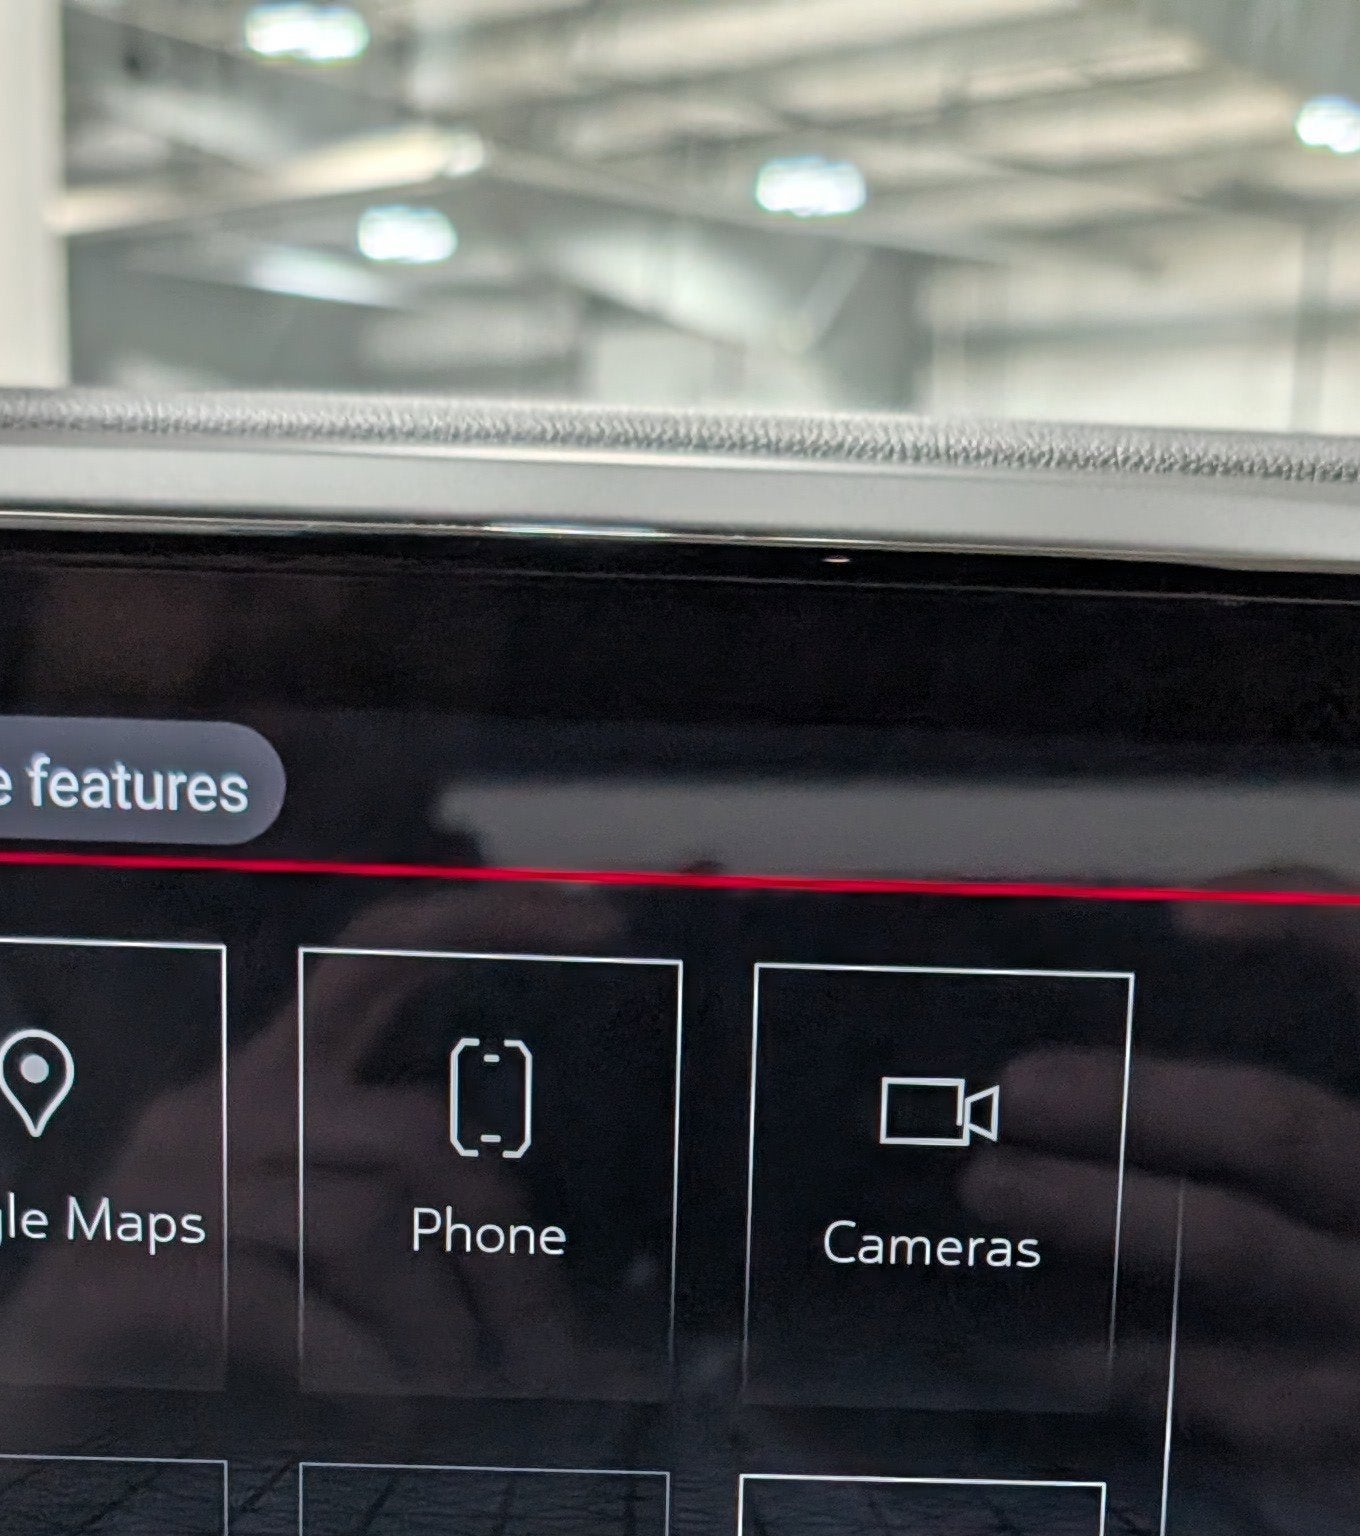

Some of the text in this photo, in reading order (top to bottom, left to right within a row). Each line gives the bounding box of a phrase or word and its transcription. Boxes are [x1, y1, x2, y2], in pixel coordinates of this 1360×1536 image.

[27, 754, 250, 814] features
[67, 1195, 207, 1256] Maps
[411, 1206, 566, 1257] Phone
[823, 1219, 1042, 1269] Cameras
